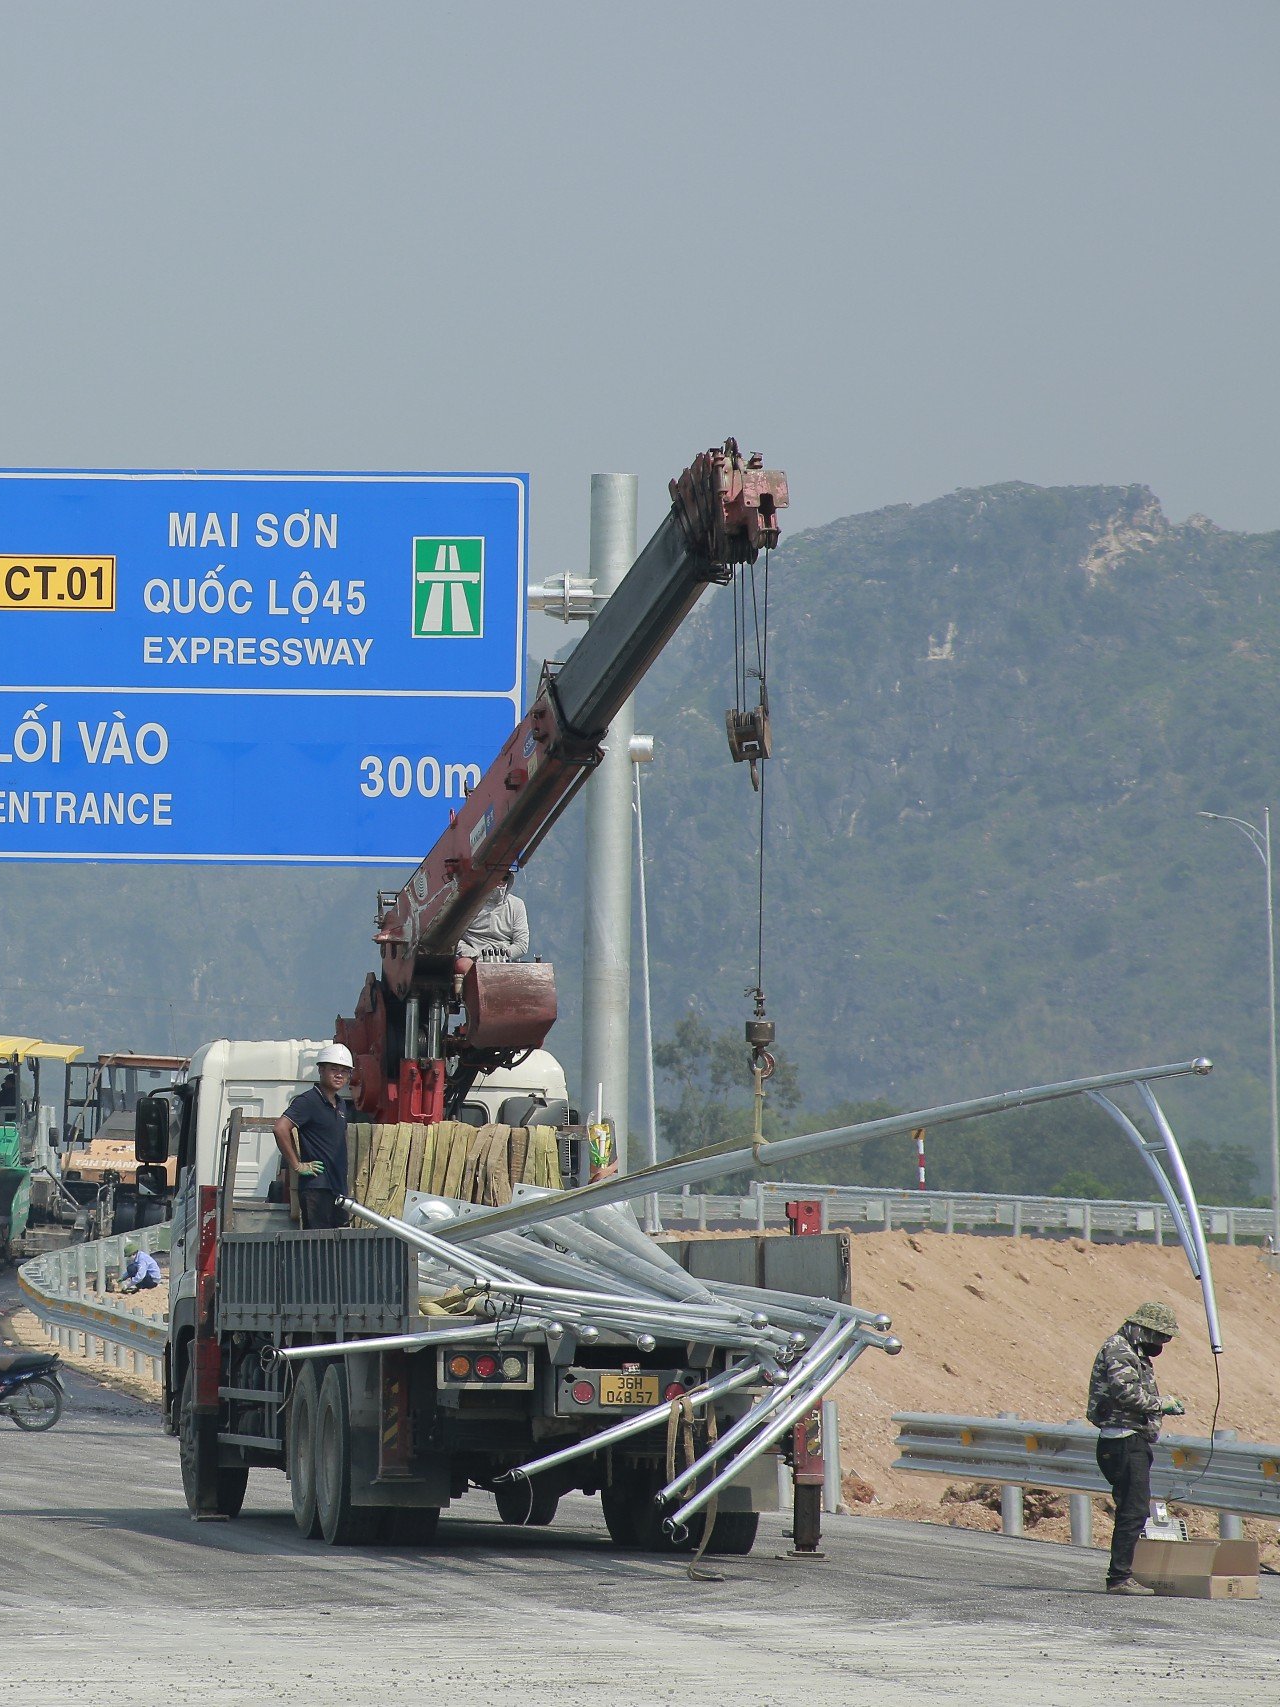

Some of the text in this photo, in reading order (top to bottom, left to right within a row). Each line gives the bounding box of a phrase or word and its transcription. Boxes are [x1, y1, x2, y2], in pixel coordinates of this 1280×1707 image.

[167, 508, 338, 549] MAI SƠN
[3, 564, 105, 602] CT.01
[143, 563, 367, 625] QUỐC LỘ45
[143, 635, 374, 667] EXPRESSWAY
[77, 710, 169, 765] VÀO
[359, 754, 482, 800] 300m
[606, 1390, 653, 1404] 048.57
[617, 1377, 643, 1390] 36H
